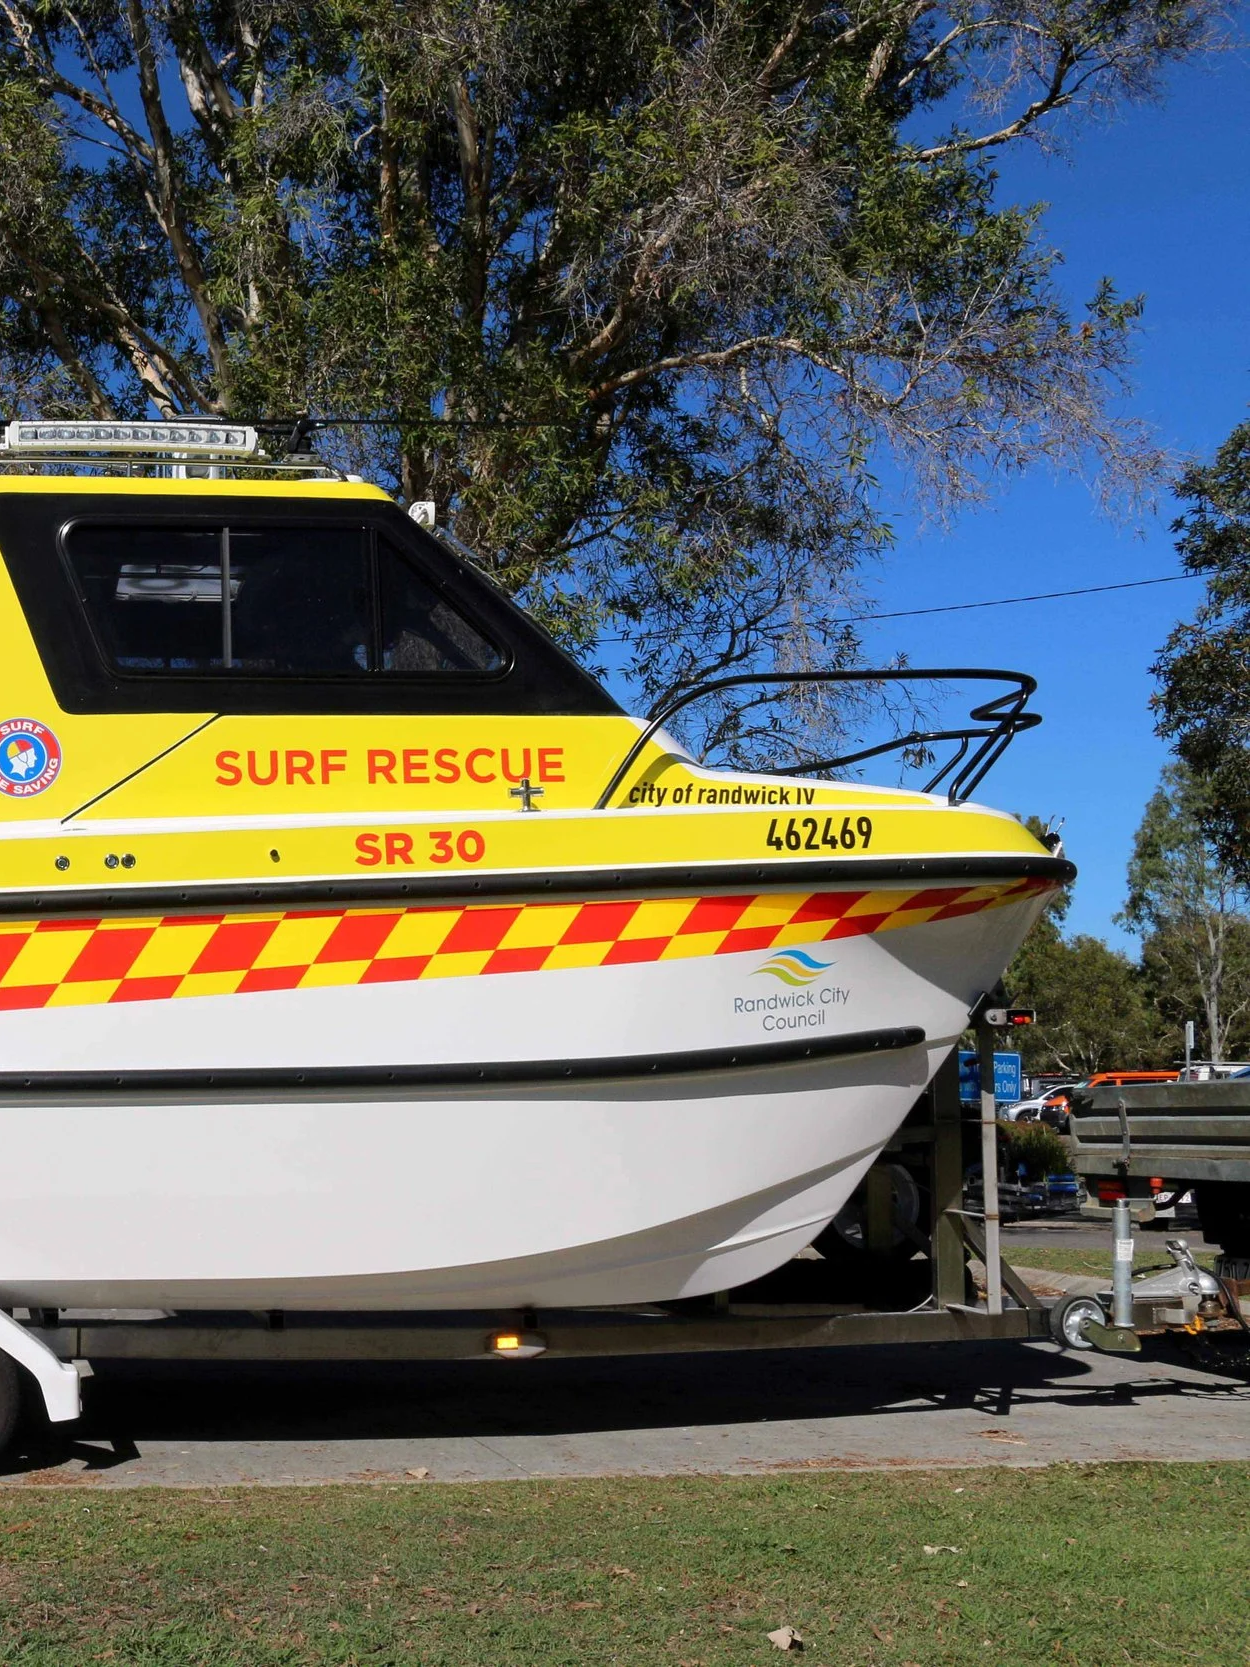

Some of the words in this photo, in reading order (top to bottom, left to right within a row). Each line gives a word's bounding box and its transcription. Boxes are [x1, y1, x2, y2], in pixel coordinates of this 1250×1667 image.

[0, 721, 45, 736] SURF
[13, 757, 59, 795] SAVING
[214, 749, 348, 787] SURF
[366, 747, 566, 785] RESCUE
[628, 782, 668, 807] city
[672, 783, 694, 804] of
[697, 785, 790, 805] randwick
[796, 788, 815, 805] IV
[766, 816, 873, 851] 462469
[354, 832, 416, 867] SR
[428, 829, 486, 865] 30
[734, 990, 815, 1013] Randwick
[819, 986, 851, 1005] City
[762, 1009, 826, 1031] Council
[993, 1061, 1017, 1078] Parking
[1001, 1081, 1017, 1097] Only
